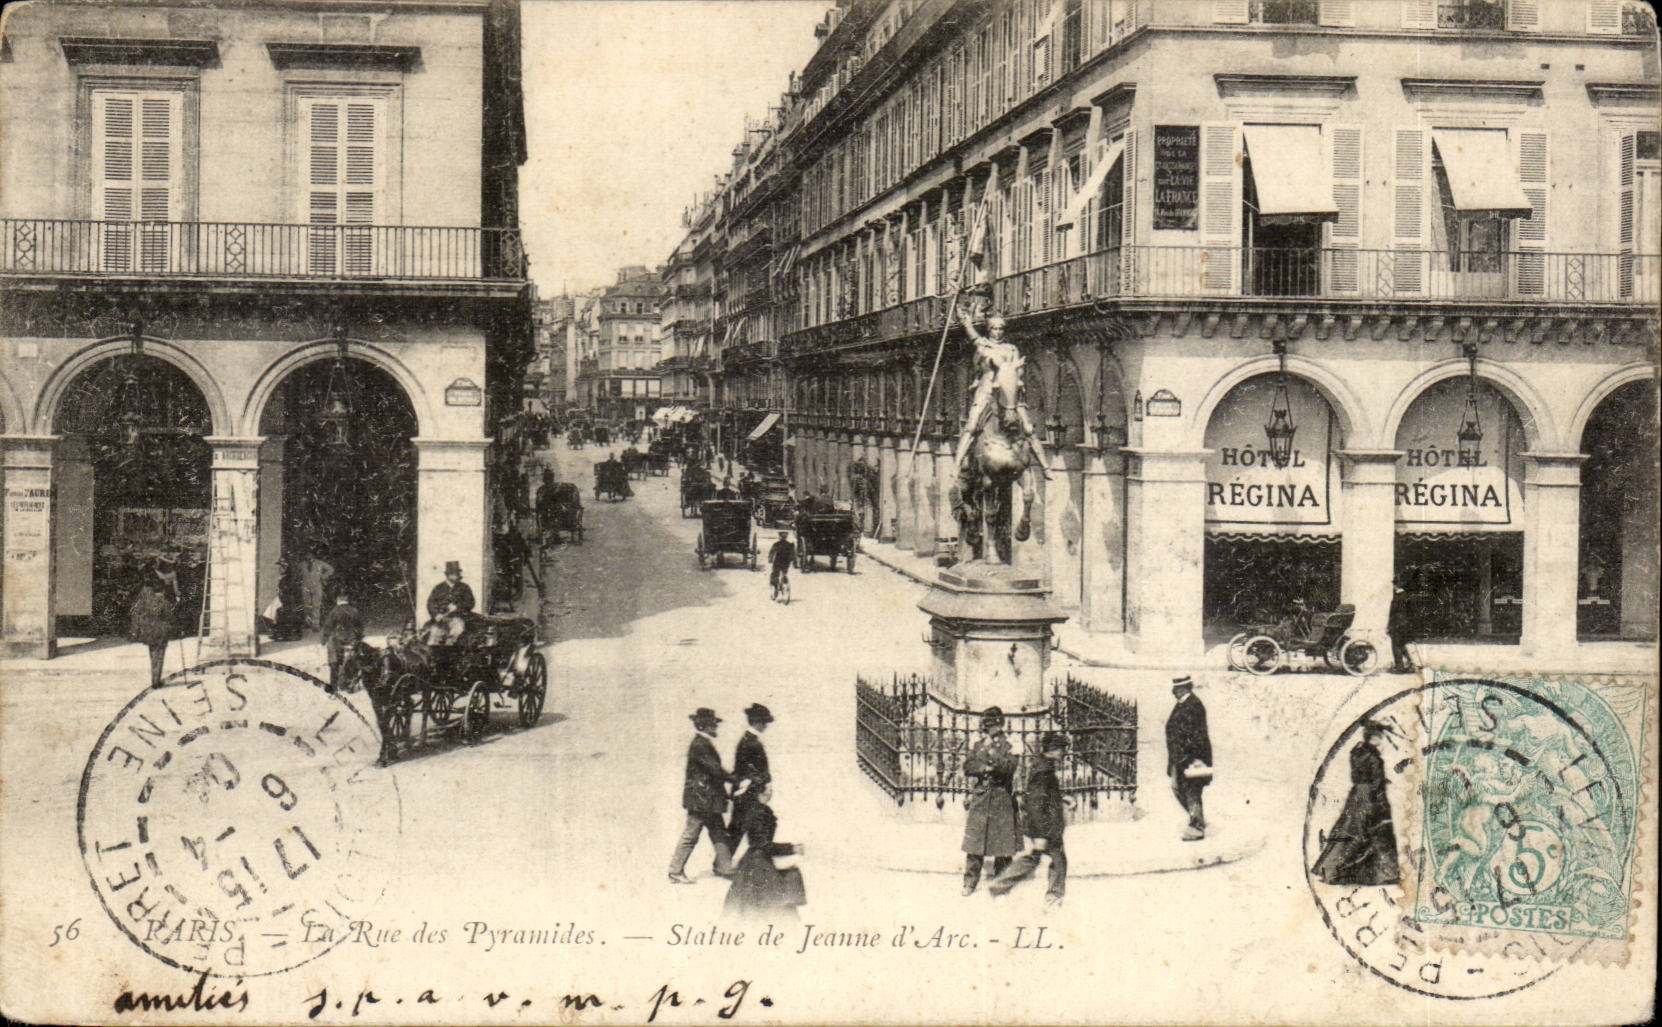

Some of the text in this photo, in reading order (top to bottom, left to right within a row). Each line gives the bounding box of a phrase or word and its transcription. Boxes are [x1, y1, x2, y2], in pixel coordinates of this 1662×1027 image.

[1222, 445, 1305, 469] HÔTEL
[1407, 445, 1488, 468] HÔTEL
[1208, 477, 1320, 508] RÉGINA
[1395, 478, 1502, 508] RÉGINA
[1474, 902, 1569, 931] POSTES
